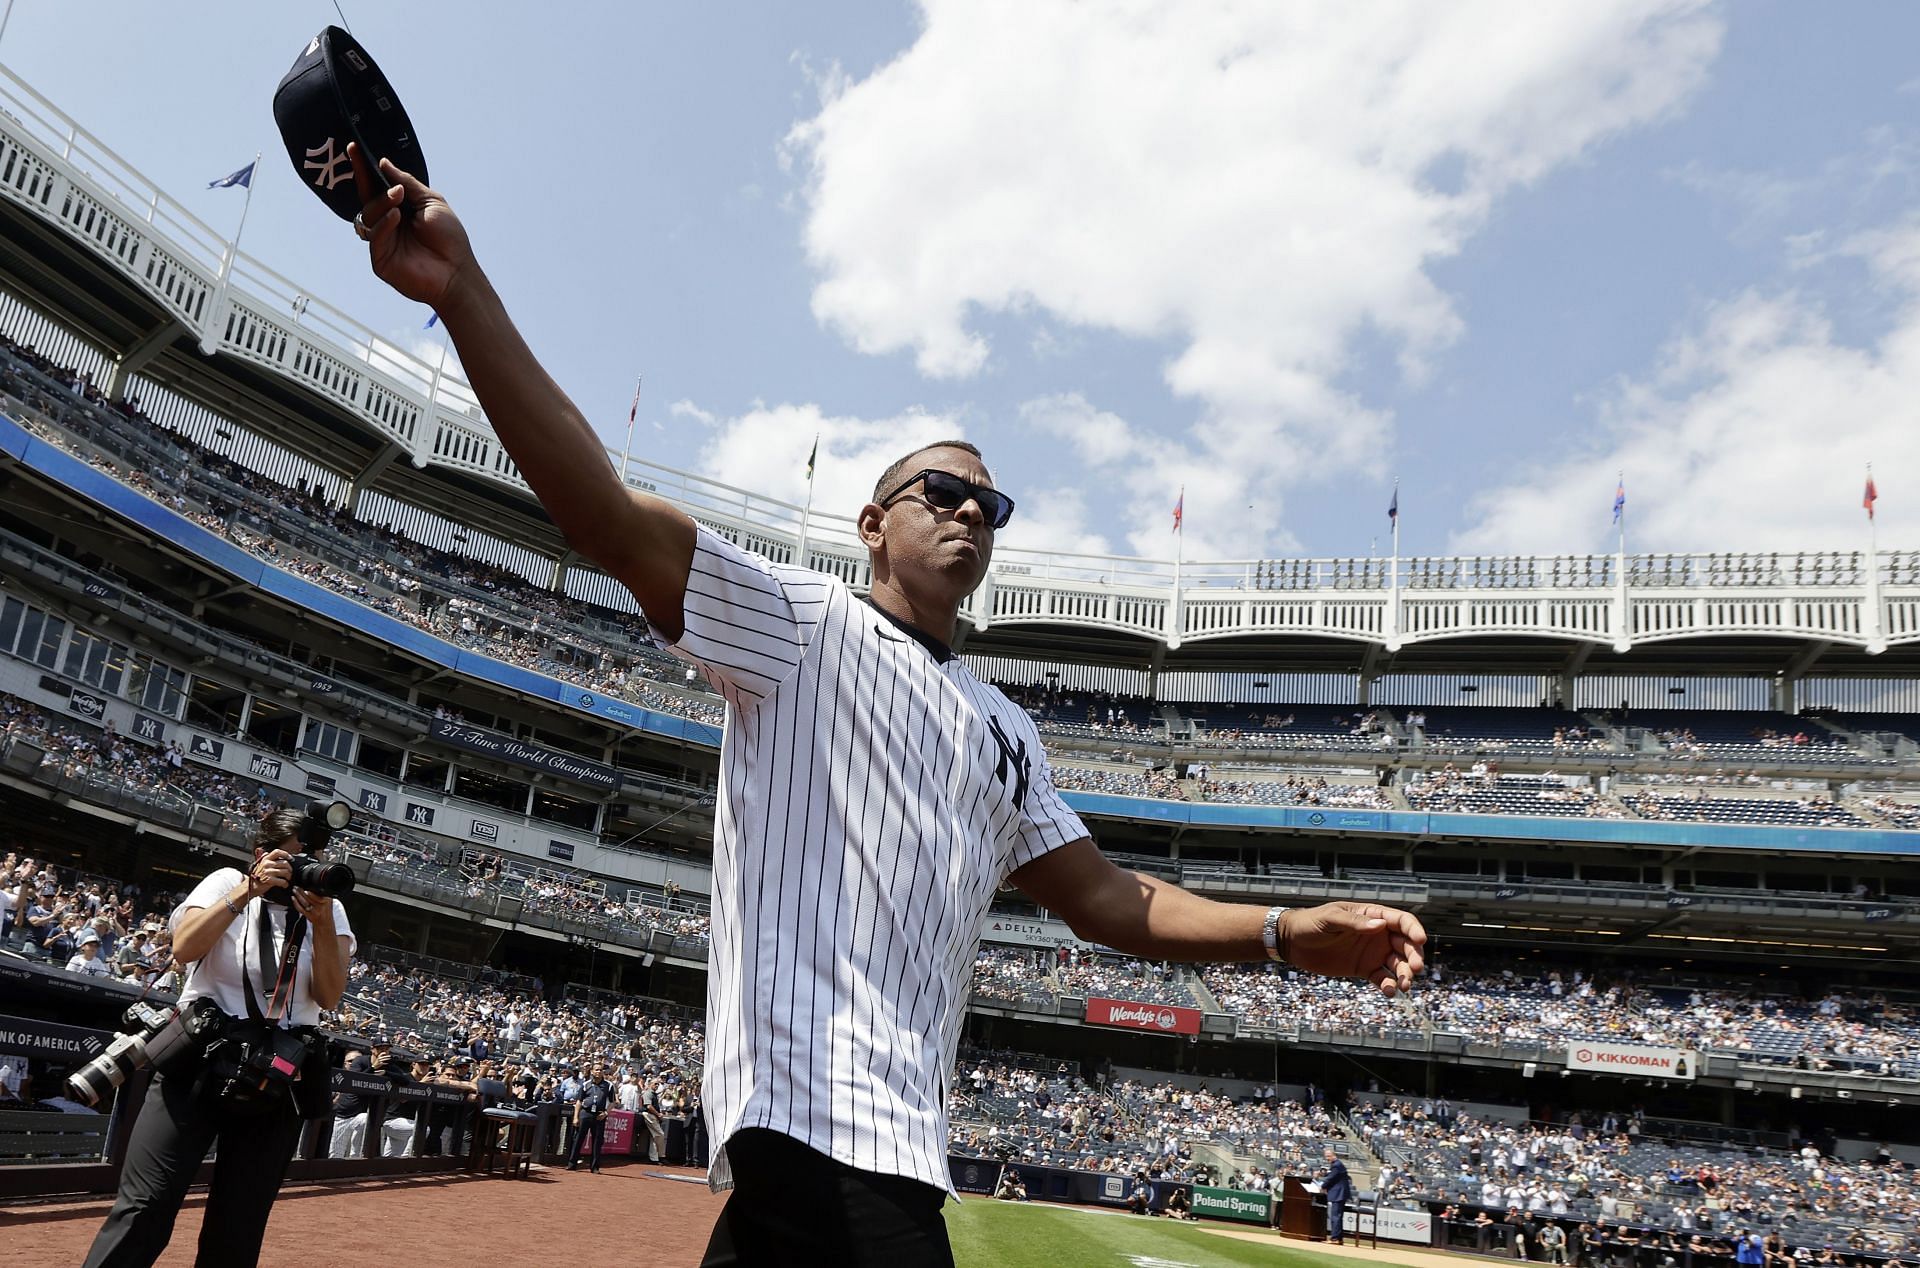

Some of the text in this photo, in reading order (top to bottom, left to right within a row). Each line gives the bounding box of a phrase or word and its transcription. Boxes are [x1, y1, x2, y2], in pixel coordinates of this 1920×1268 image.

[85, 584, 109, 596] 1951
[312, 682, 333, 692] 1952
[140, 719, 156, 738] NY
[439, 723, 615, 784] 27-Time World Champions
[251, 759, 279, 779] WFAN
[365, 792, 380, 810] NY
[411, 806, 428, 823] NY
[476, 824, 494, 835] YES
[1005, 923, 1042, 934] DELTA
[1053, 937, 1074, 946] SUITE
[287, 944, 298, 964] EOS
[1109, 1006, 1156, 1026] Wendy's
[18, 1033, 33, 1045] OF
[33, 1036, 80, 1052] AMERICA
[1596, 1052, 1670, 1067] KIKKOMAN
[369, 1082, 385, 1091] AMERICA
[1192, 1192, 1267, 1217] Poland Spring
